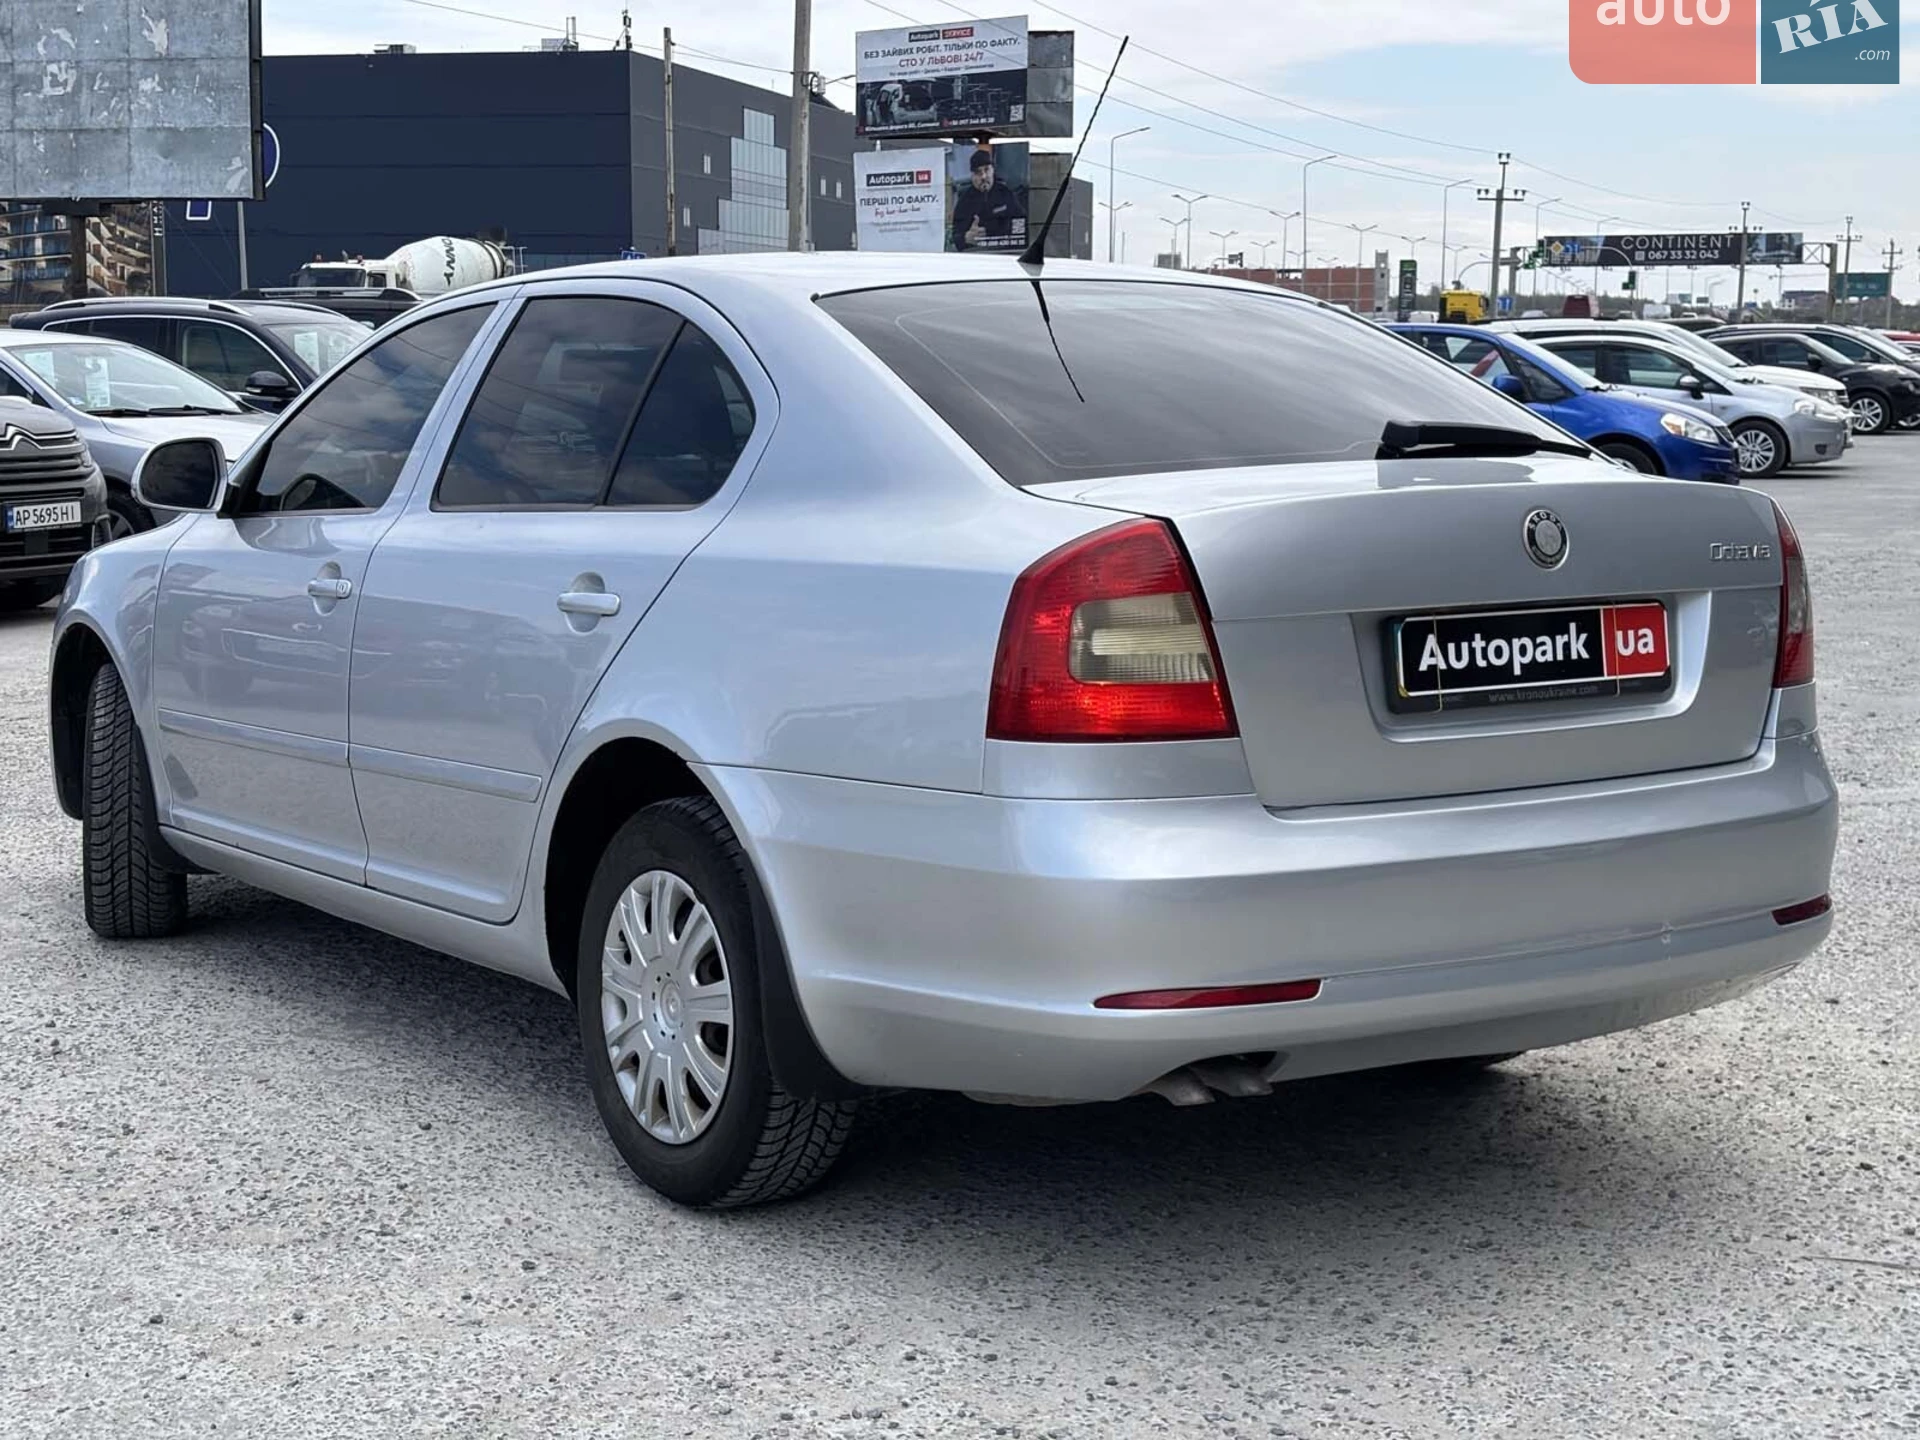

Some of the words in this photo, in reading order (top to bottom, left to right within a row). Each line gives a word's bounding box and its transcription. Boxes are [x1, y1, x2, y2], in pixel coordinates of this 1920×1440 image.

[910, 30, 938, 41] Autopark
[864, 50, 879, 59] БЕЗ
[881, 46, 914, 58] ЗАЙВИХ
[944, 42, 973, 52] ТІЛЬКИ
[975, 40, 988, 49] ПО
[989, 37, 1020, 47] ФАКТУ.
[899, 57, 917, 68] СТО
[919, 56, 925, 66] У
[927, 54, 962, 65] ЛЬВОВІ
[964, 52, 984, 62] 24/7
[869, 172, 911, 185] Autopark
[860, 197, 888, 206] ПЕРШІ
[891, 196, 904, 205] ПО
[906, 194, 939, 204] ФАКТУ.
[1621, 235, 1735, 249] CONTINENT
[1648, 251, 1667, 260] 067
[1670, 251, 1683, 260] 33
[1684, 250, 1697, 259] 32
[1699, 250, 1720, 259] 043
[16, 509, 31, 526] AP
[33, 506, 59, 524] 5695
[60, 505, 75, 522] HI
[1709, 542, 1771, 560] Octavia
[1418, 622, 1590, 676] Autopark
[1616, 626, 1655, 656] ua
